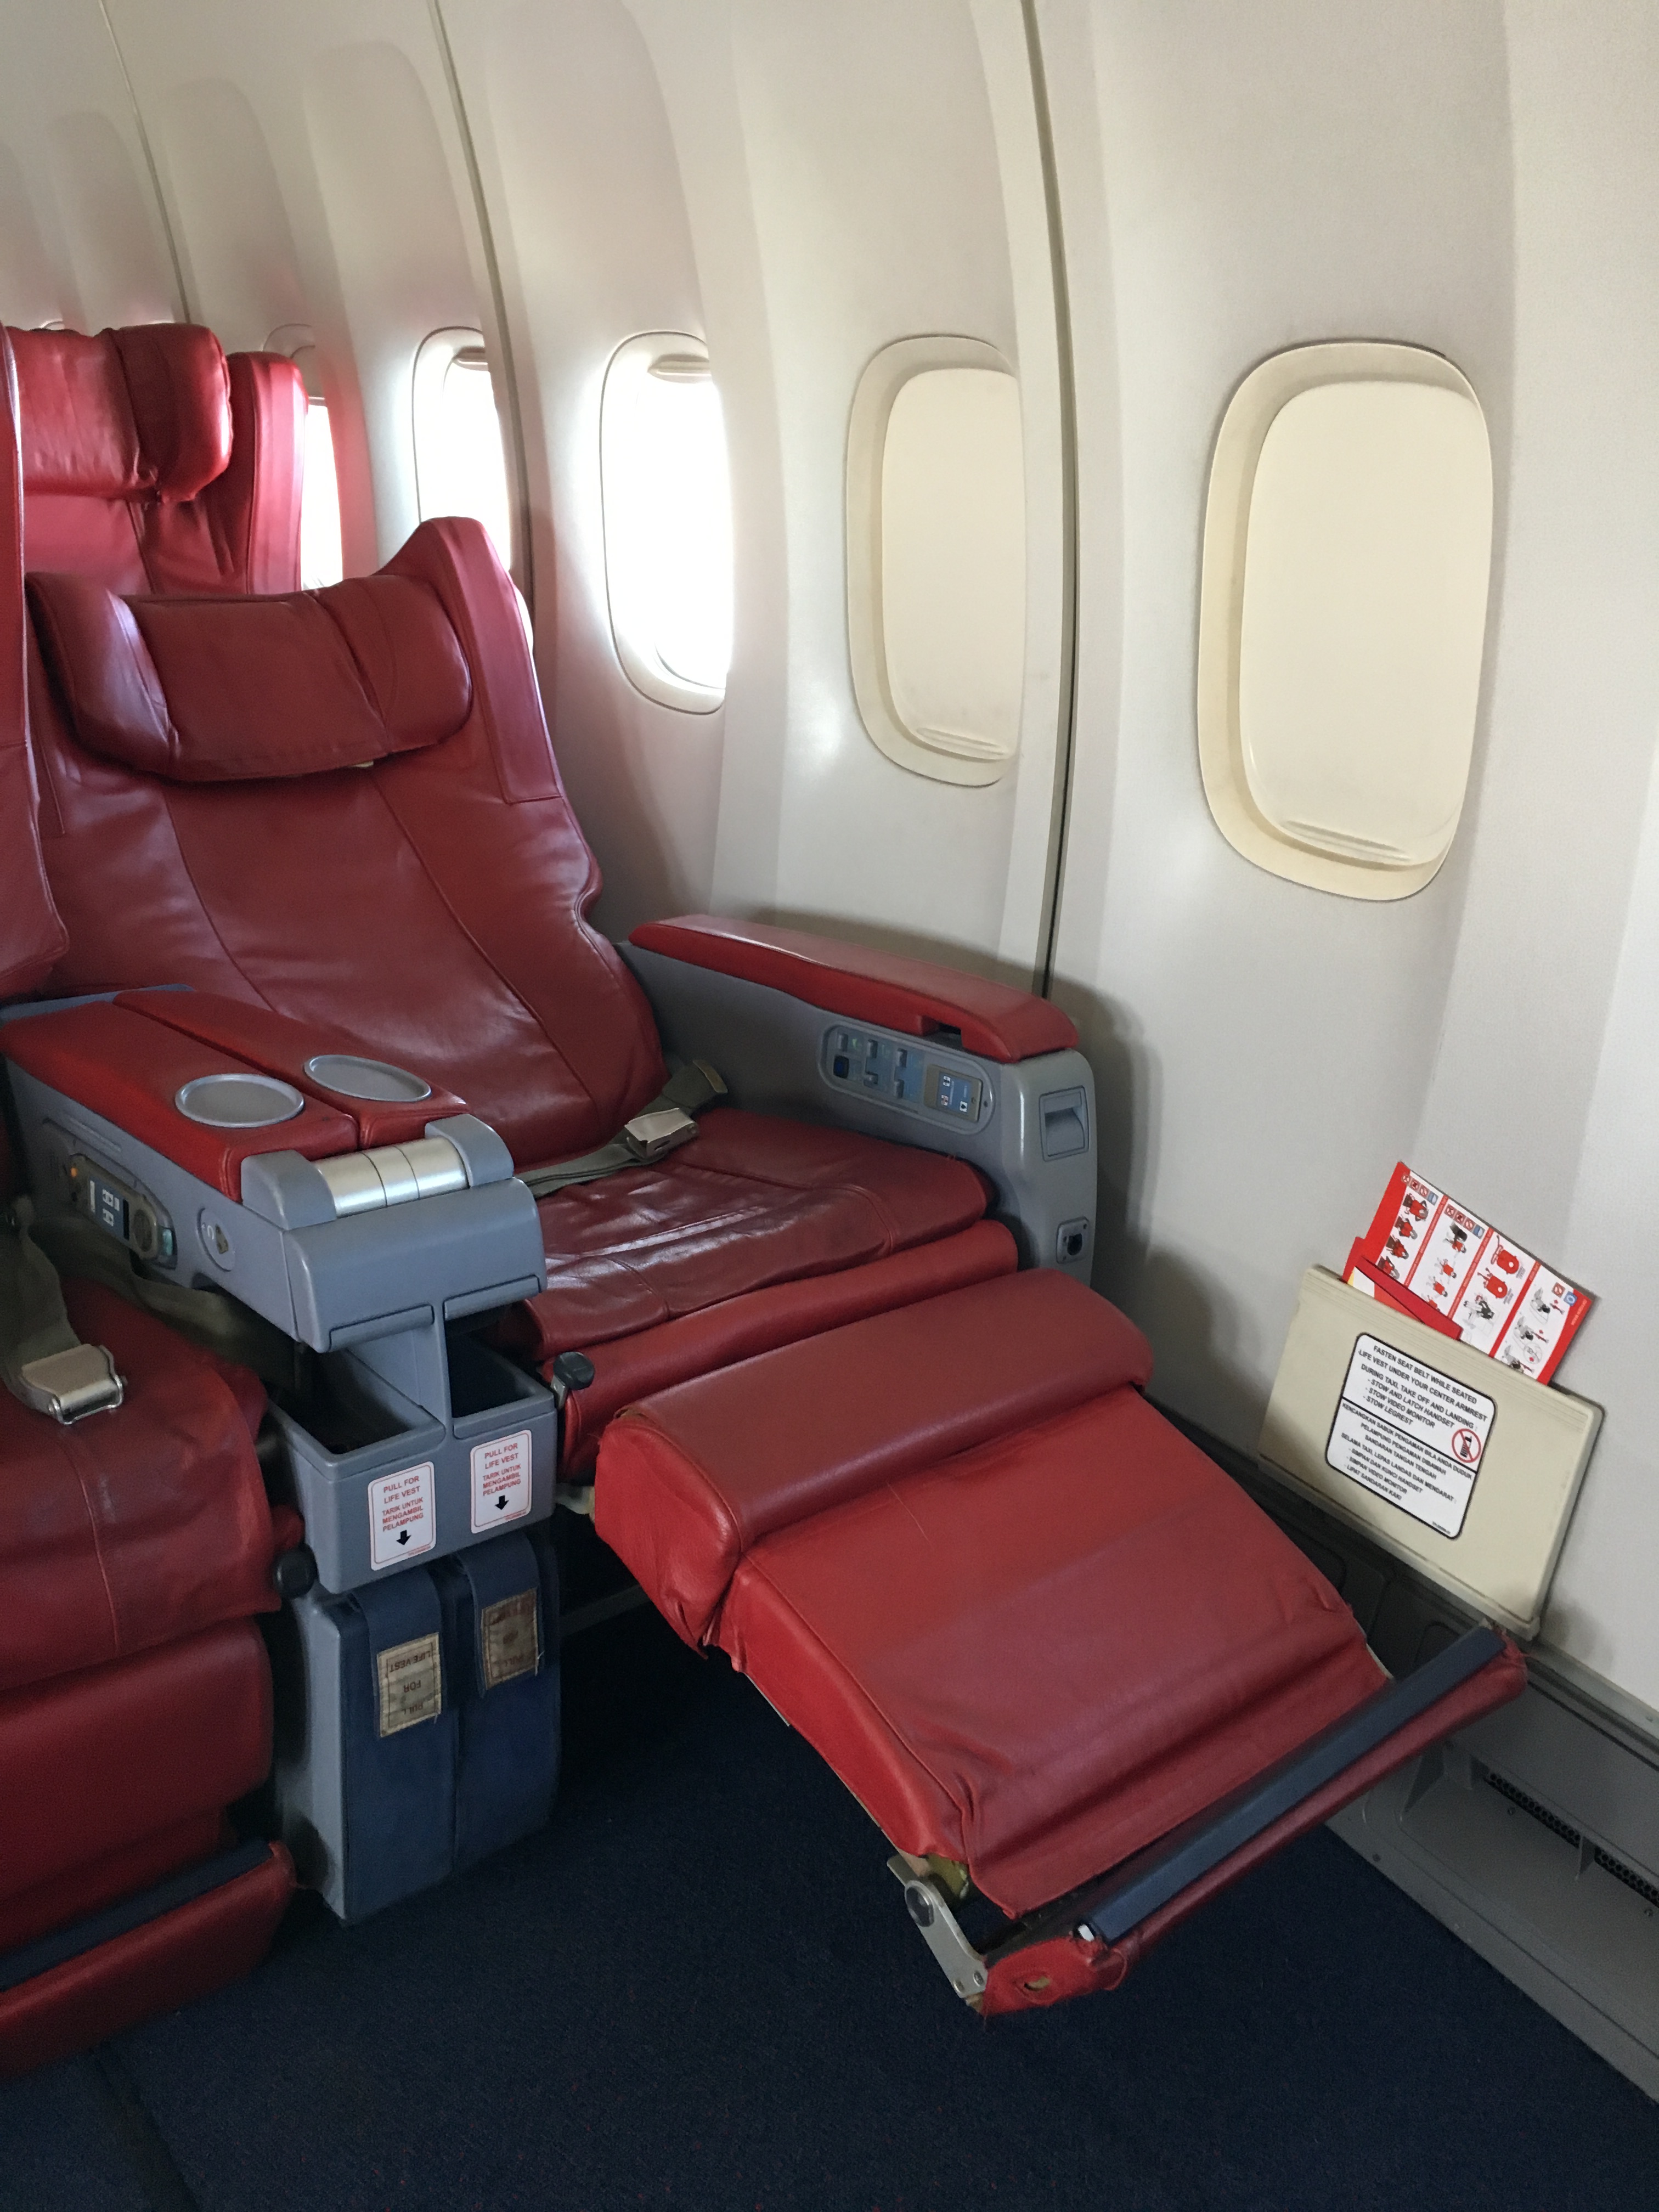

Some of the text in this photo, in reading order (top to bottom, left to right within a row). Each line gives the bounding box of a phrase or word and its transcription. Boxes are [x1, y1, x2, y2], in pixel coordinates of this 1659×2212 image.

[1374, 1345, 1477, 1404] FASTEN SEAT BELT WHILE SEATED
[1361, 1364, 1384, 1380] DURING
[1401, 1385, 1416, 1397] TAKE
[1417, 1395, 1430, 1404] OFF
[1430, 1402, 1444, 1413] AND
[1445, 1409, 1474, 1429] LANDING
[1373, 1357, 1388, 1369] VEST
[1389, 1365, 1410, 1381] UNDER
[1412, 1377, 1428, 1391] YOUR
[1429, 1387, 1455, 1405] CENTER
[1455, 1402, 1487, 1422] ARMREST
[1366, 1396, 1385, 1409] STOW
[1385, 1406, 1413, 1425] LEGREST
[1368, 1388, 1387, 1401] STOW
[1387, 1397, 1406, 1412] VIDEO
[1406, 1409, 1435, 1428] MONITOR
[1371, 1379, 1390, 1392] STOW
[1389, 1390, 1402, 1400] AND
[1403, 1397, 1423, 1411] LATCH
[1424, 1408, 1455, 1428] HANDSET
[485, 1443, 518, 1459] PULL FOR
[1342, 1403, 1376, 1425] KENCANGKAN
[1395, 1432, 1424, 1452] PENGAMAN
[1437, 1457, 1452, 1468] ANDA
[1453, 1465, 1472, 1480] DUDUK
[1361, 1423, 1391, 1443] PELAMPUNG
[1392, 1441, 1421, 1460] PENGAMAN
[485, 1453, 518, 1469] LIFE VEST
[1365, 1435, 1437, 1479] SANDARAN TANGAN TENGAH
[483, 1464, 521, 1481] TARIK UNTUK
[1341, 1432, 1361, 1447] SELAMA
[1374, 1452, 1391, 1464] LEPAS
[1391, 1462, 1412, 1477] LANDAS
[1413, 1474, 1424, 1485] DAN
[1424, 1481, 1454, 1502] MENDARAT
[1370, 1459, 1381, 1469] DAN
[1398, 1476, 1423, 1493] HANDSET
[383, 1476, 419, 1493] PULL FOR
[483, 1472, 520, 1488] MENGAMBIL
[483, 1479, 521, 1496] PELAMPUNG
[1361, 1473, 1389, 1492] SANDARAN
[1384, 1477, 1408, 1494] MONITOR
[384, 1486, 420, 1504] LIFE VEST
[382, 1497, 423, 1516] TARIK UNTUK
[382, 1505, 423, 1523] MENGAMBIL
[383, 1513, 424, 1532] PELAMPUNG
[390, 1651, 431, 1672] LIFE VEST
[404, 1680, 421, 1693] FOR
[402, 1702, 424, 1714] PULL
